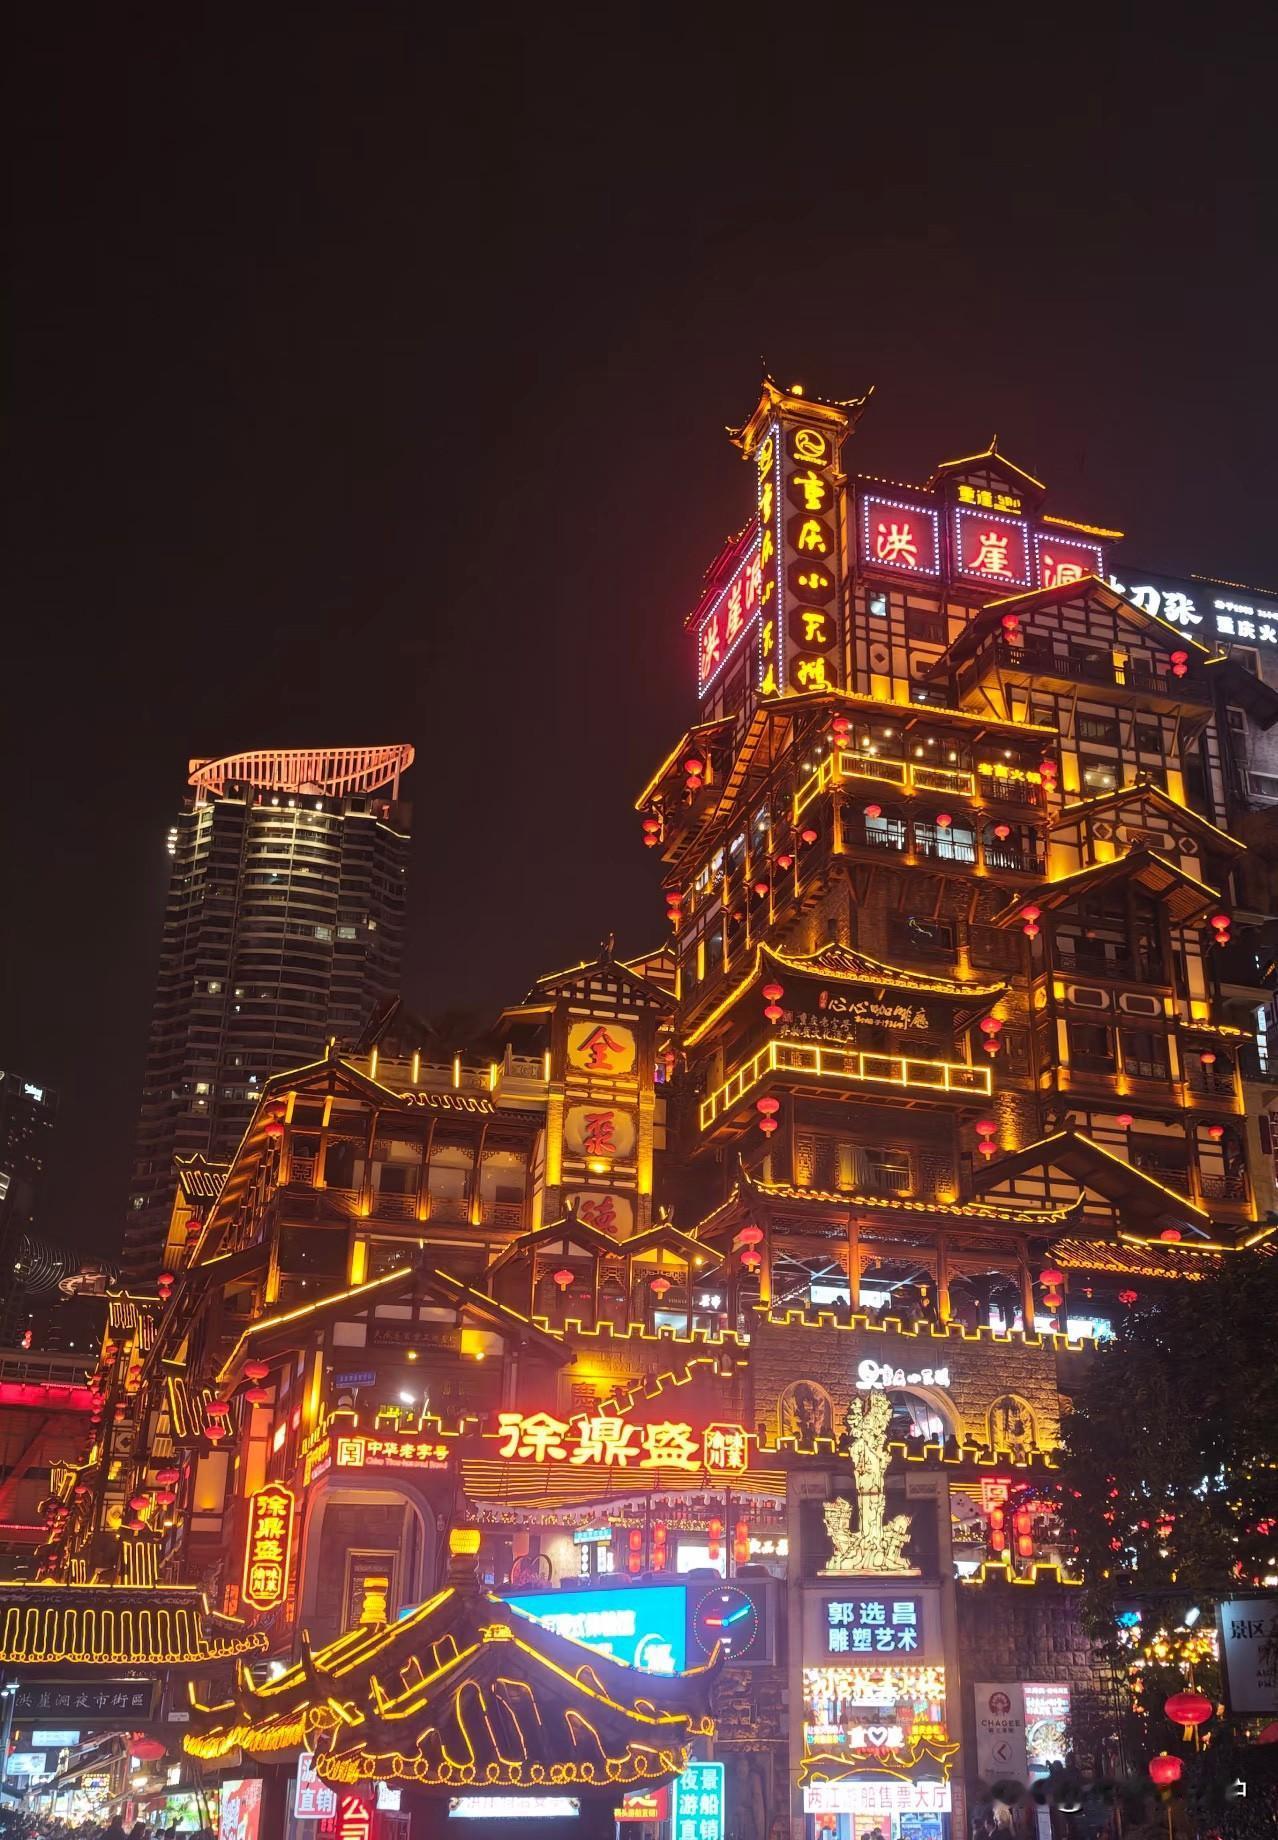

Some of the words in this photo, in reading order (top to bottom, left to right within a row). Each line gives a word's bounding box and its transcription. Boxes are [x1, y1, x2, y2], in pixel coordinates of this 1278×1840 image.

[367, 1441, 449, 1460] 中华老字号
[498, 1412, 702, 1472] 徐鼎盛
[253, 1495, 288, 1562] 徐鼎盛
[828, 1602, 916, 1625] 郭选昌
[828, 1627, 918, 1652] 雕塑艺术
[680, 1768, 719, 1790] 夜景
[300, 1789, 333, 1811] 直销
[680, 1794, 719, 1815] 游船
[680, 1820, 719, 1840] 直销
